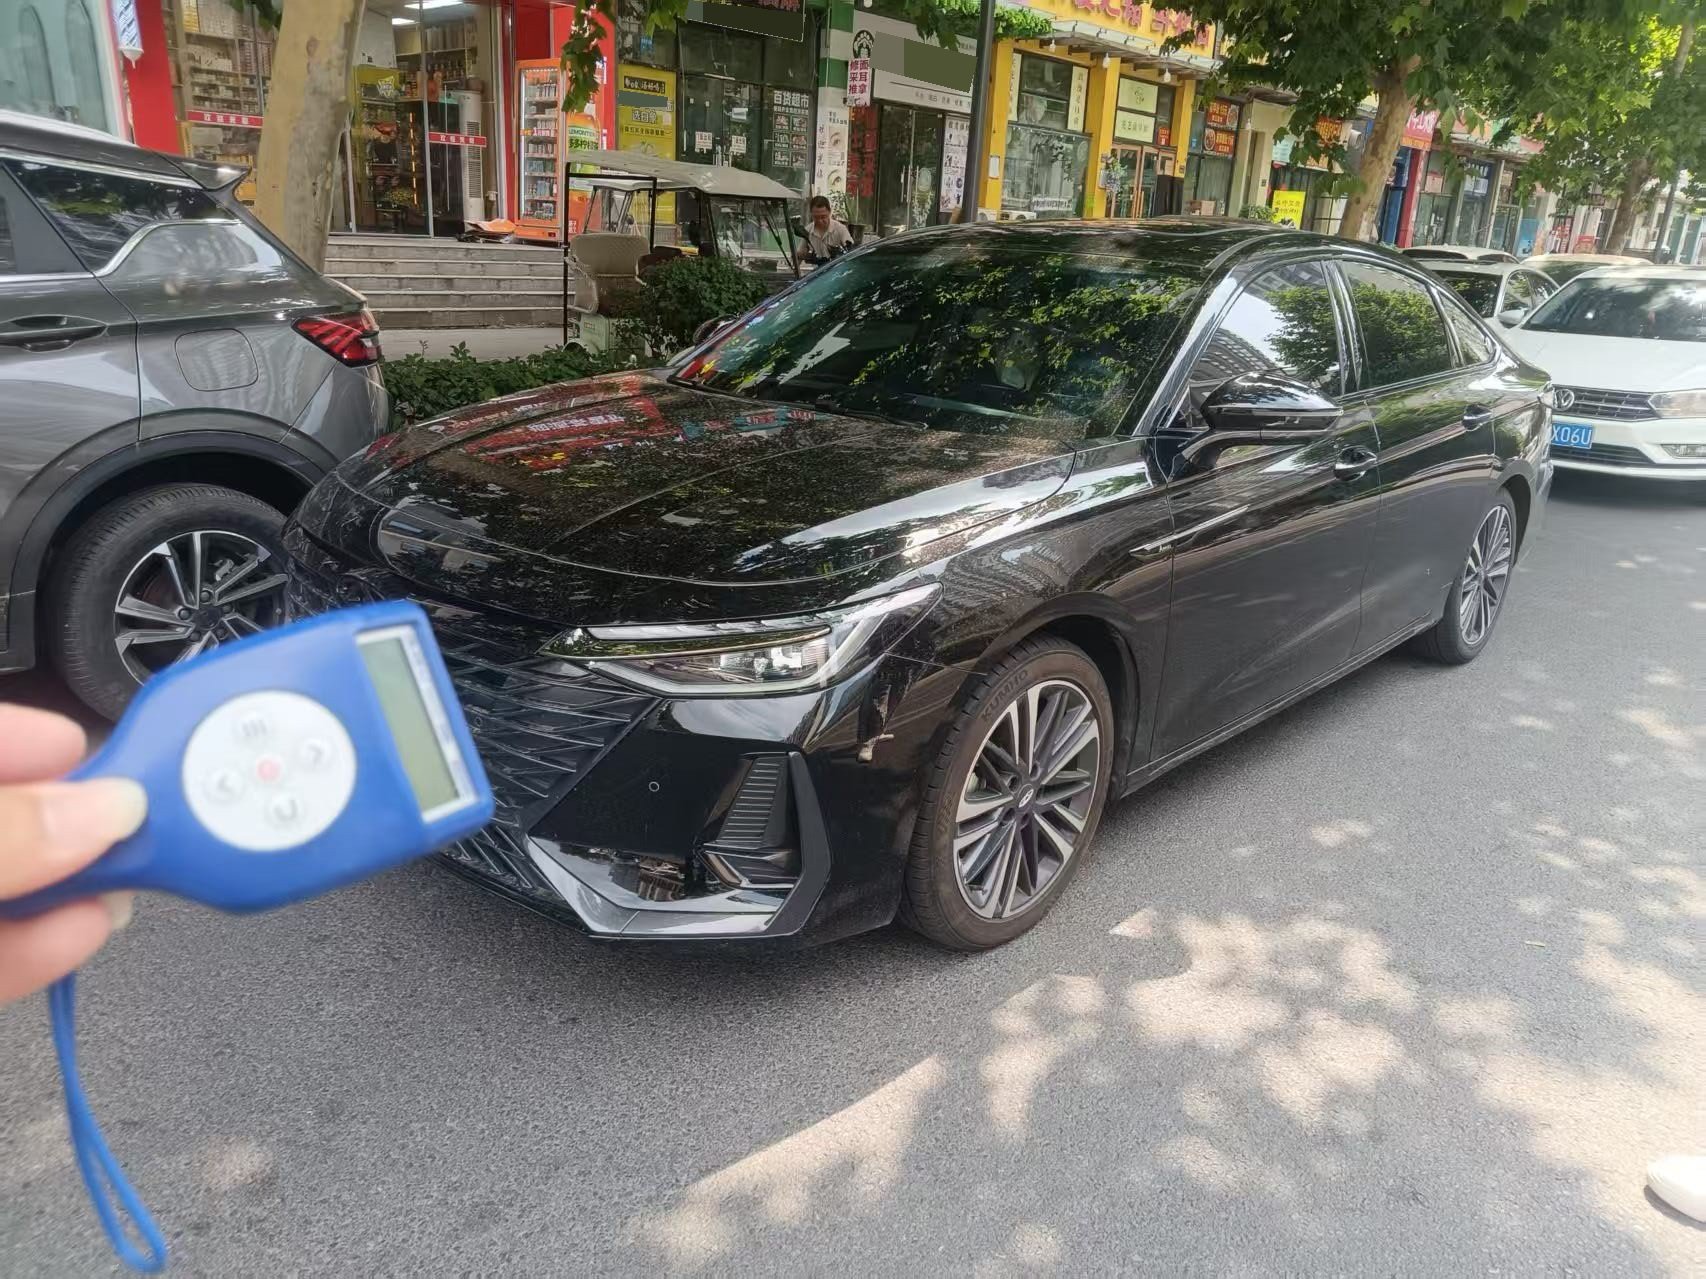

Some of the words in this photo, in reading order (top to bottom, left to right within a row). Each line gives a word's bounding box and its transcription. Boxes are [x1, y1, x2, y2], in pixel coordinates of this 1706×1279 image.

[850, 60, 869, 71] 修面
[849, 72, 868, 82] 采耳
[848, 83, 867, 94] 推拿
[773, 90, 809, 108] 百货超市
